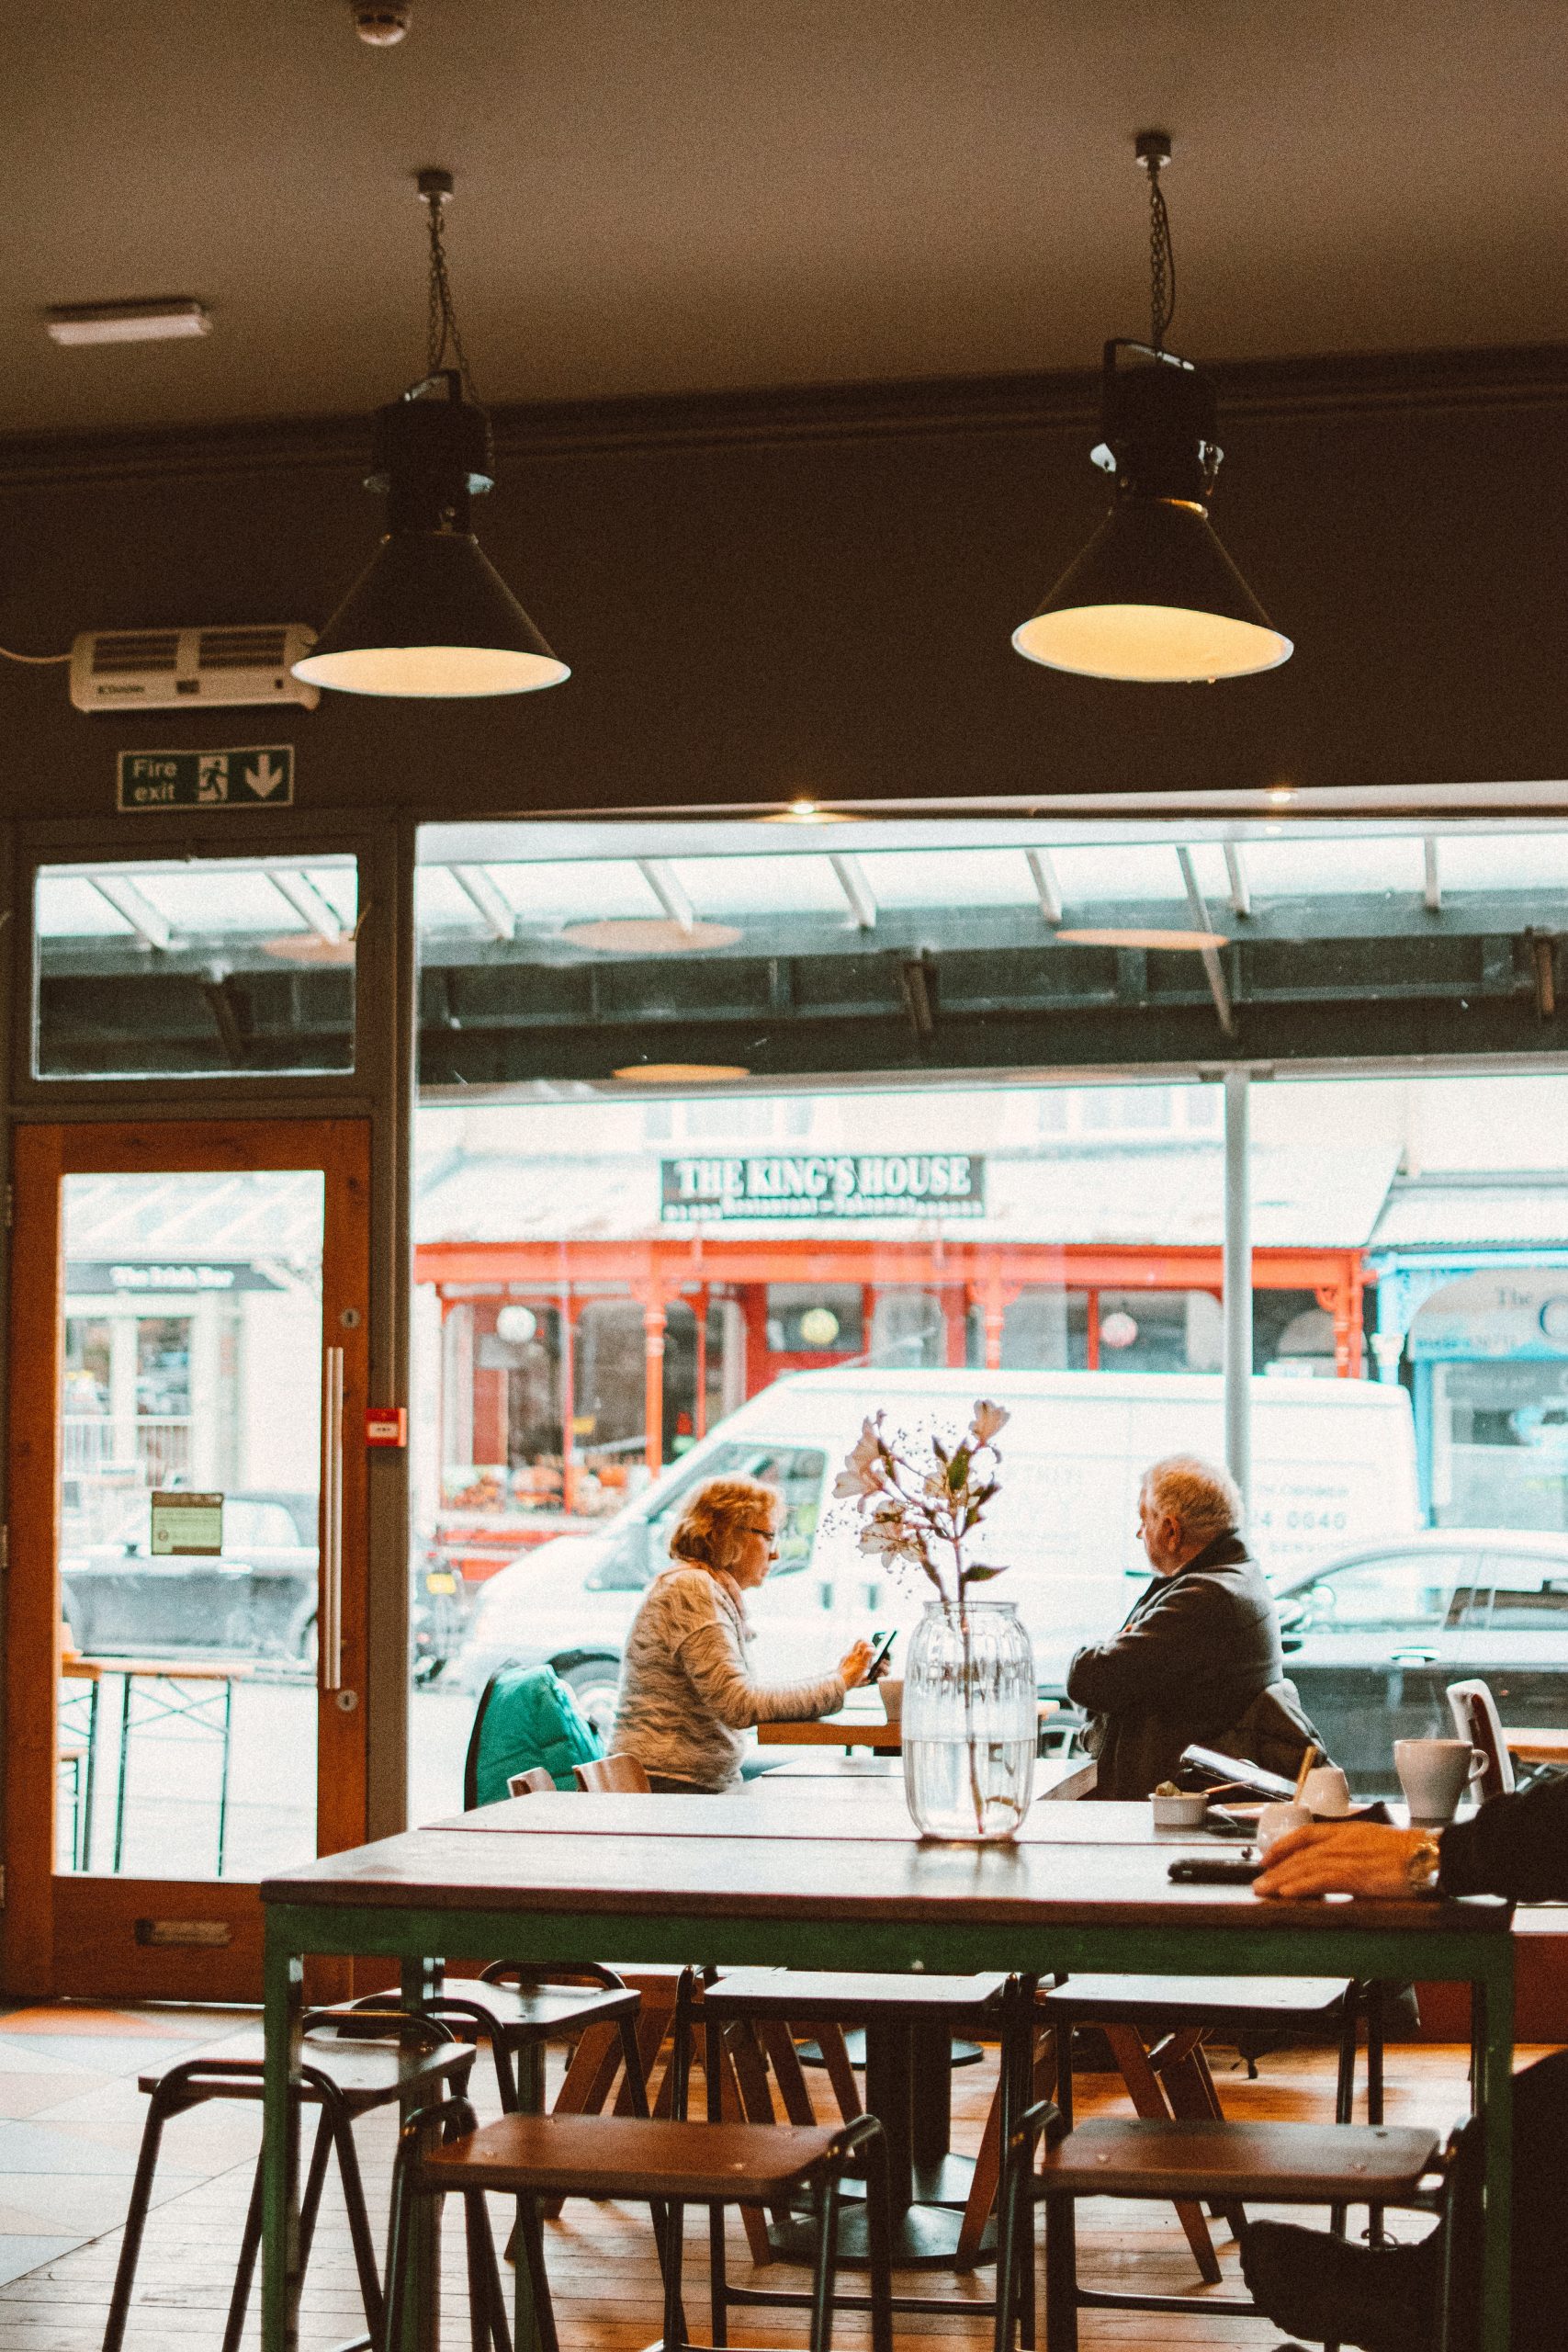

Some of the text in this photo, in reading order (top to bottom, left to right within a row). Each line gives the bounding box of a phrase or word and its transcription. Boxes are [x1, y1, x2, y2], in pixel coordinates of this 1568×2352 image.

[132, 758, 177, 778] Fire
[134, 783, 175, 801] exit
[676, 1156, 972, 1198] THE KING'S HOUSE
